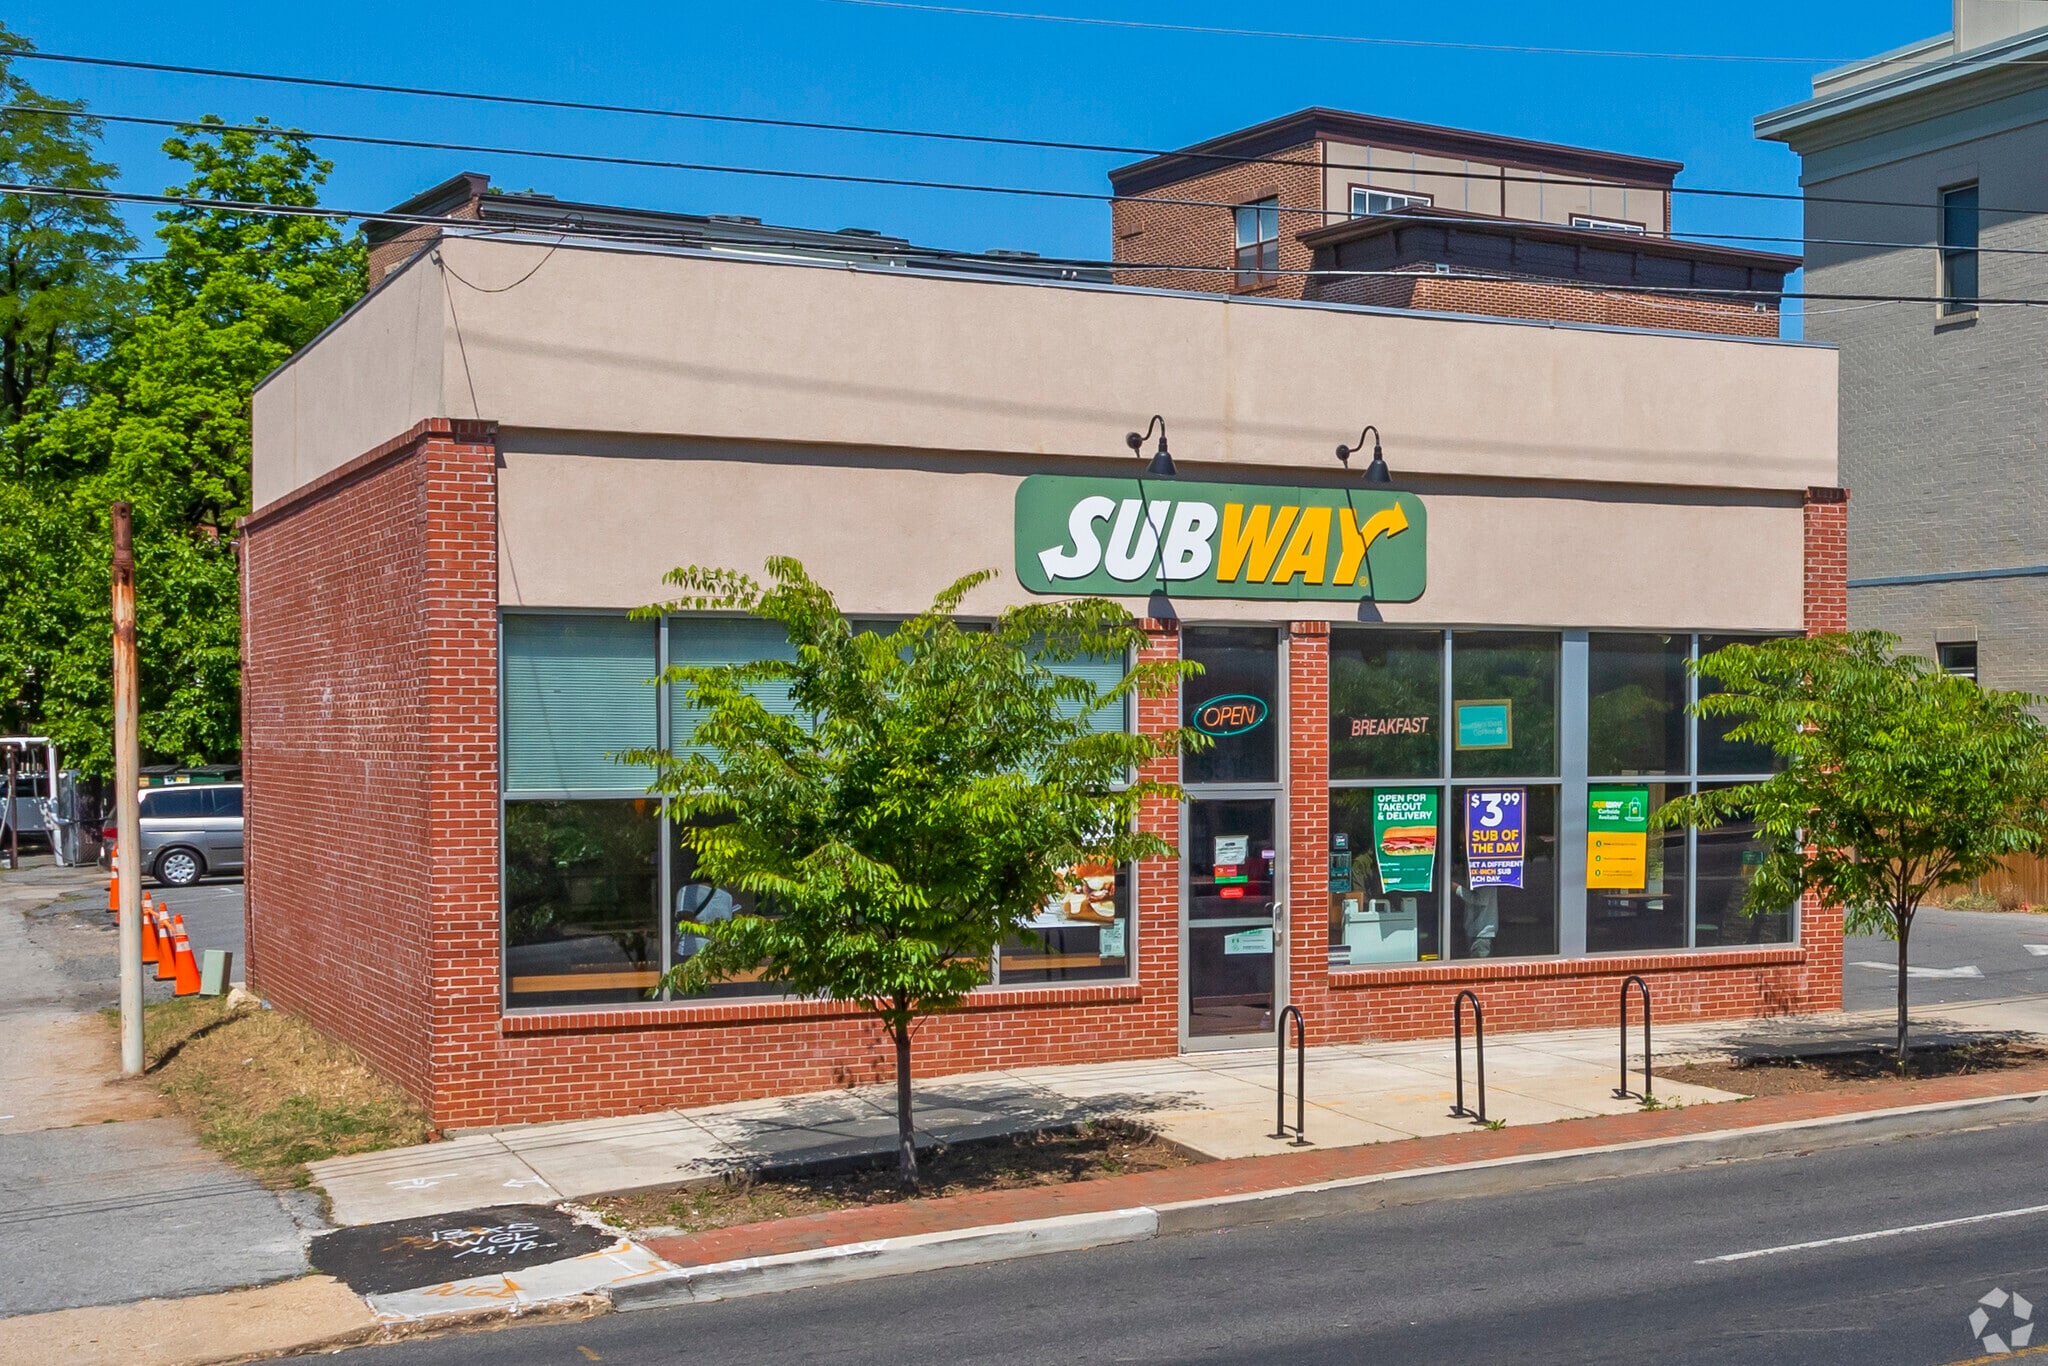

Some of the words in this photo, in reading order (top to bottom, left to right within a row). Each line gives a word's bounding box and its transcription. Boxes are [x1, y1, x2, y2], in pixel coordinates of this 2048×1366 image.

[1038, 496, 1409, 586] SUBWAY
[1203, 705, 1256, 727] OPEN
[1351, 717, 1429, 737] BREAKFAST
[1377, 794, 1405, 803] OPEN
[1407, 793, 1427, 802] FOR
[1377, 803, 1422, 811] TAKEOUT
[1377, 812, 1384, 820] &
[1386, 811, 1432, 820] DELIVERY
[1472, 830, 1499, 842] SUB
[1501, 829, 1519, 841] OF
[1471, 843, 1494, 853] THE
[1496, 842, 1519, 853] DAY
